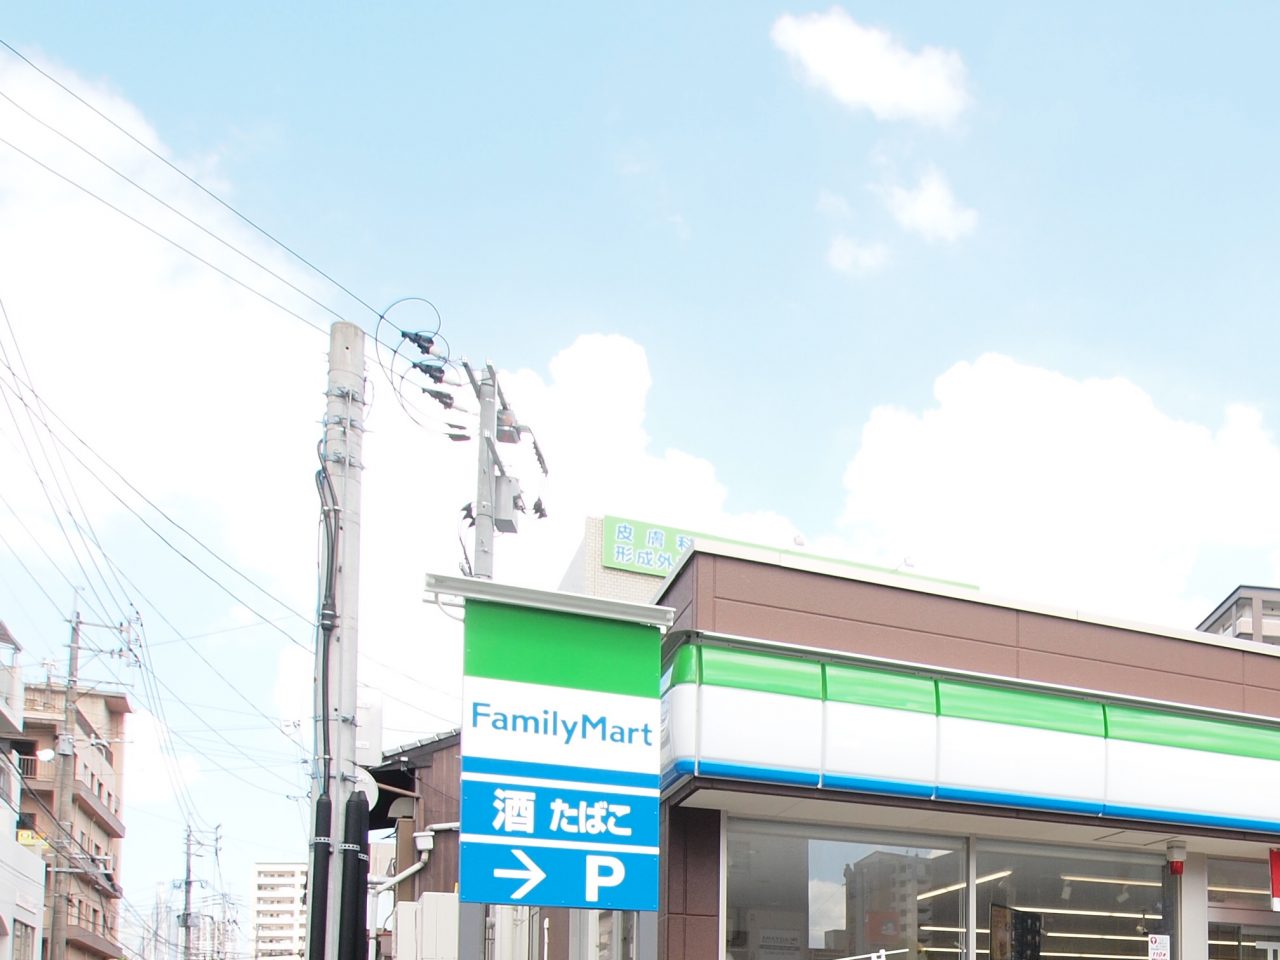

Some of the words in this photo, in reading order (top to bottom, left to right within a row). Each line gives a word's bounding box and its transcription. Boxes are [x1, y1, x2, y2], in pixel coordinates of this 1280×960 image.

[615, 545, 676, 570] 形成外
[472, 702, 652, 746] FamilyMart
[492, 788, 536, 834] 酒
[549, 798, 632, 836] たばこ
[585, 854, 626, 902] P
